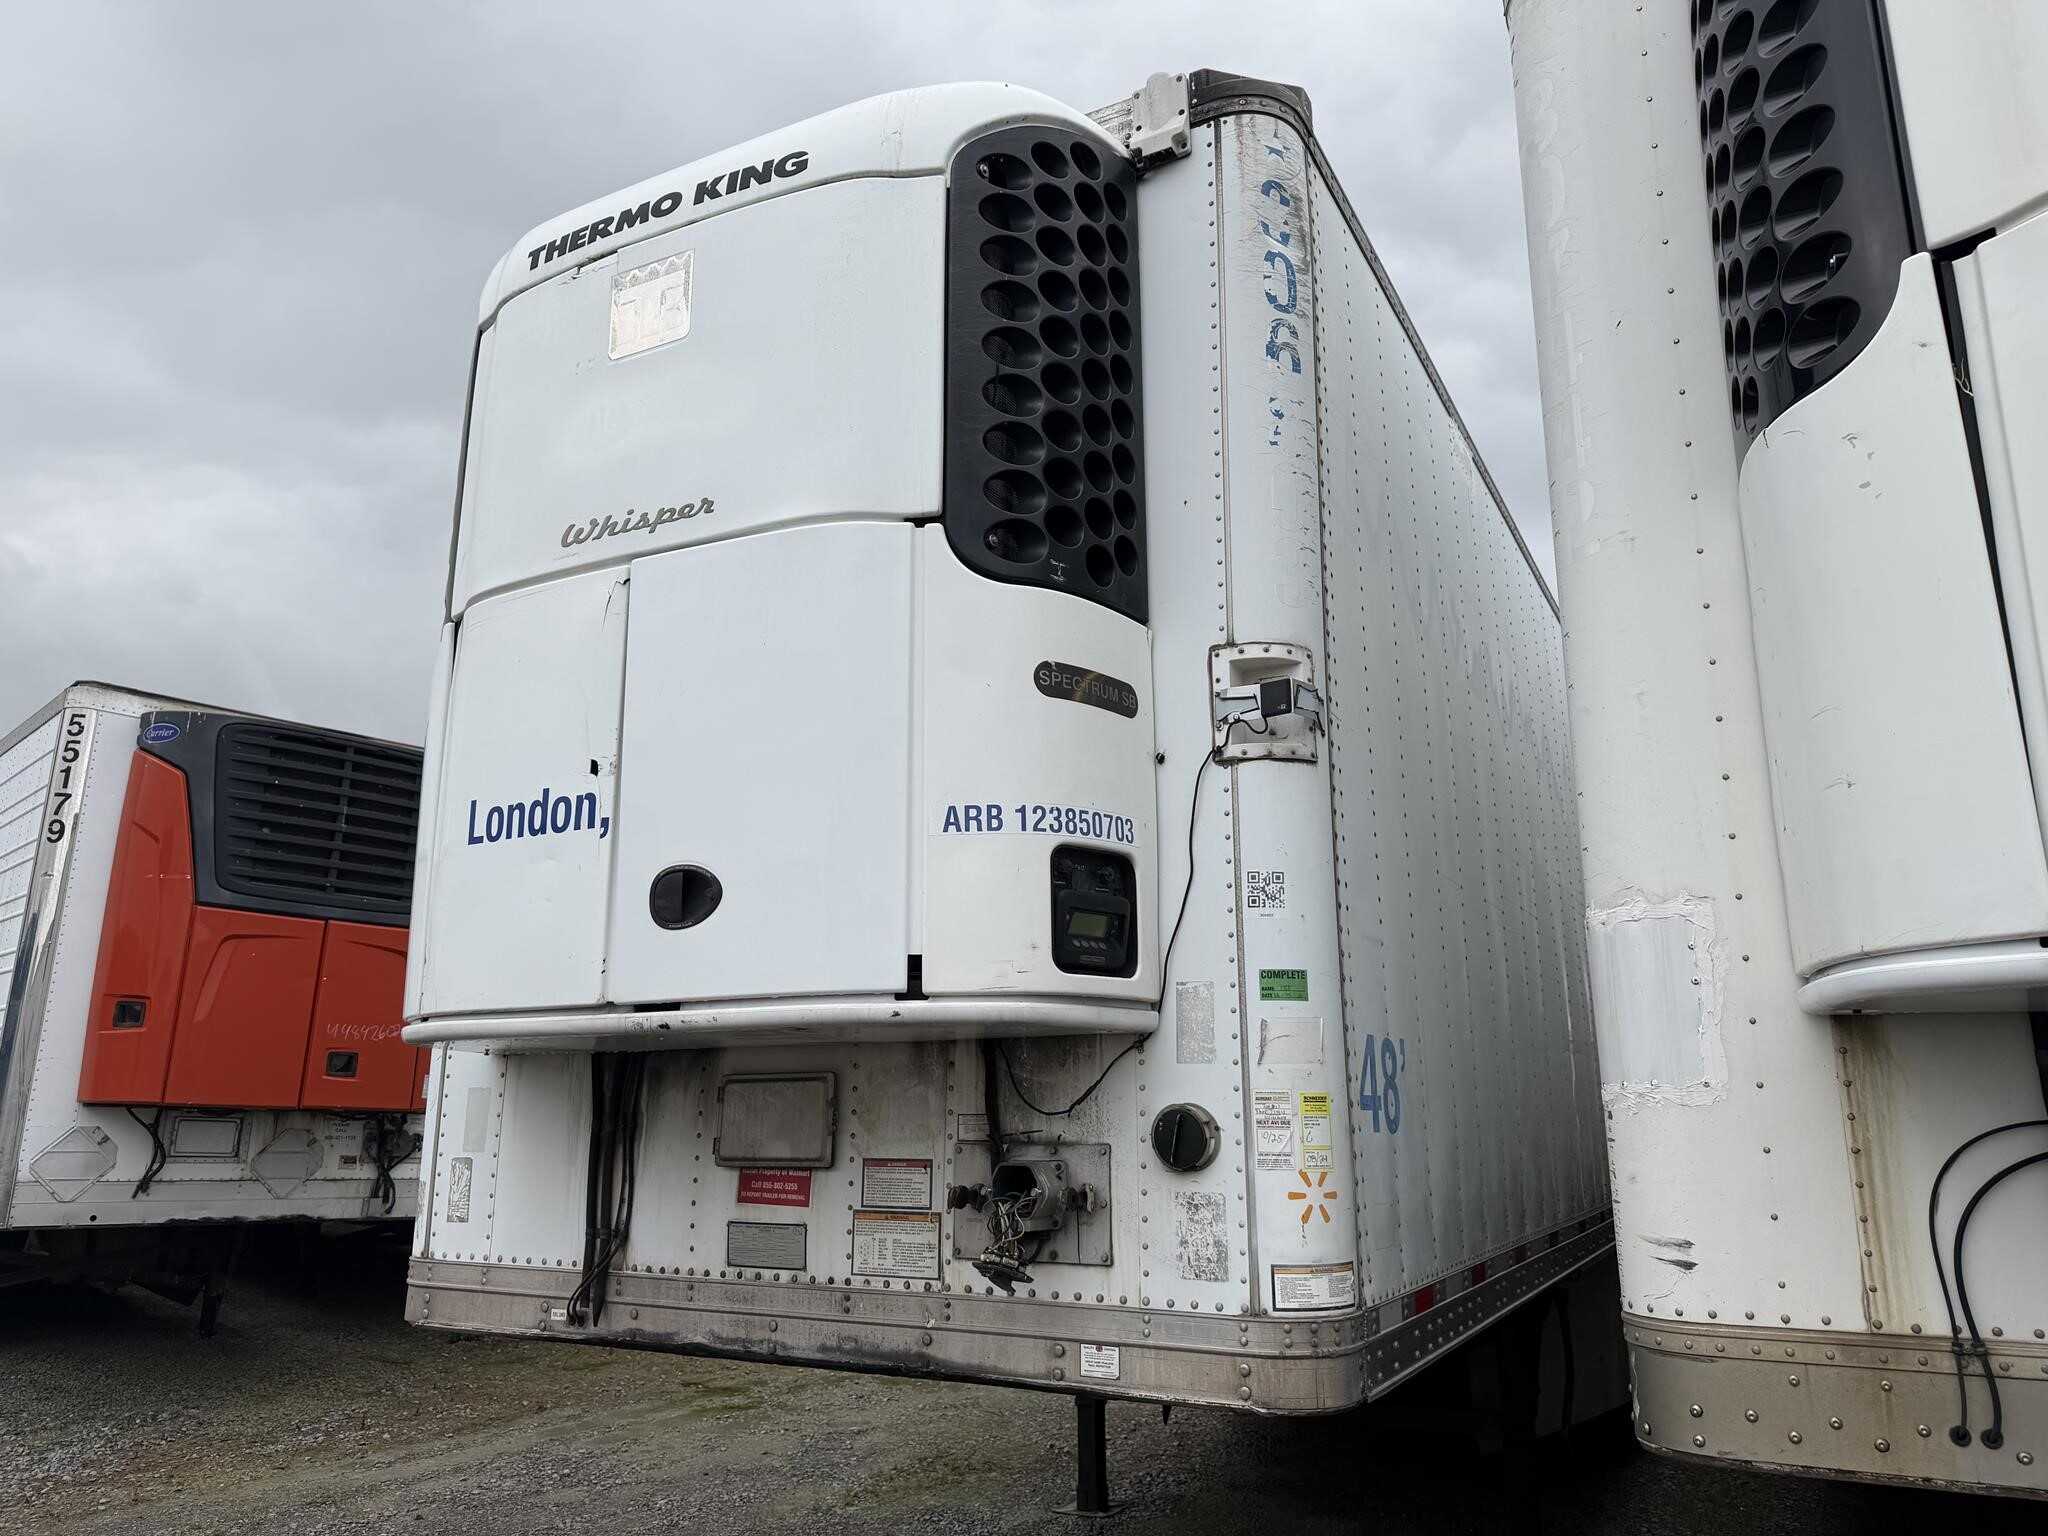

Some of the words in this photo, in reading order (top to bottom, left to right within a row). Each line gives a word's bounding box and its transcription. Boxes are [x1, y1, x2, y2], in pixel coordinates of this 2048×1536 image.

[528, 191, 683, 271] THERMO
[693, 150, 810, 206] KING
[561, 496, 715, 549] Whisper
[1038, 669, 1119, 702] SPECTRUM
[1121, 691, 1137, 709] SB
[146, 727, 174, 741] Carrier
[46, 713, 87, 844] 55179
[467, 787, 610, 846] London,
[942, 804, 1004, 833] ARB
[1014, 804, 1135, 845] 123850703
[1260, 969, 1306, 980] COMPLETE
